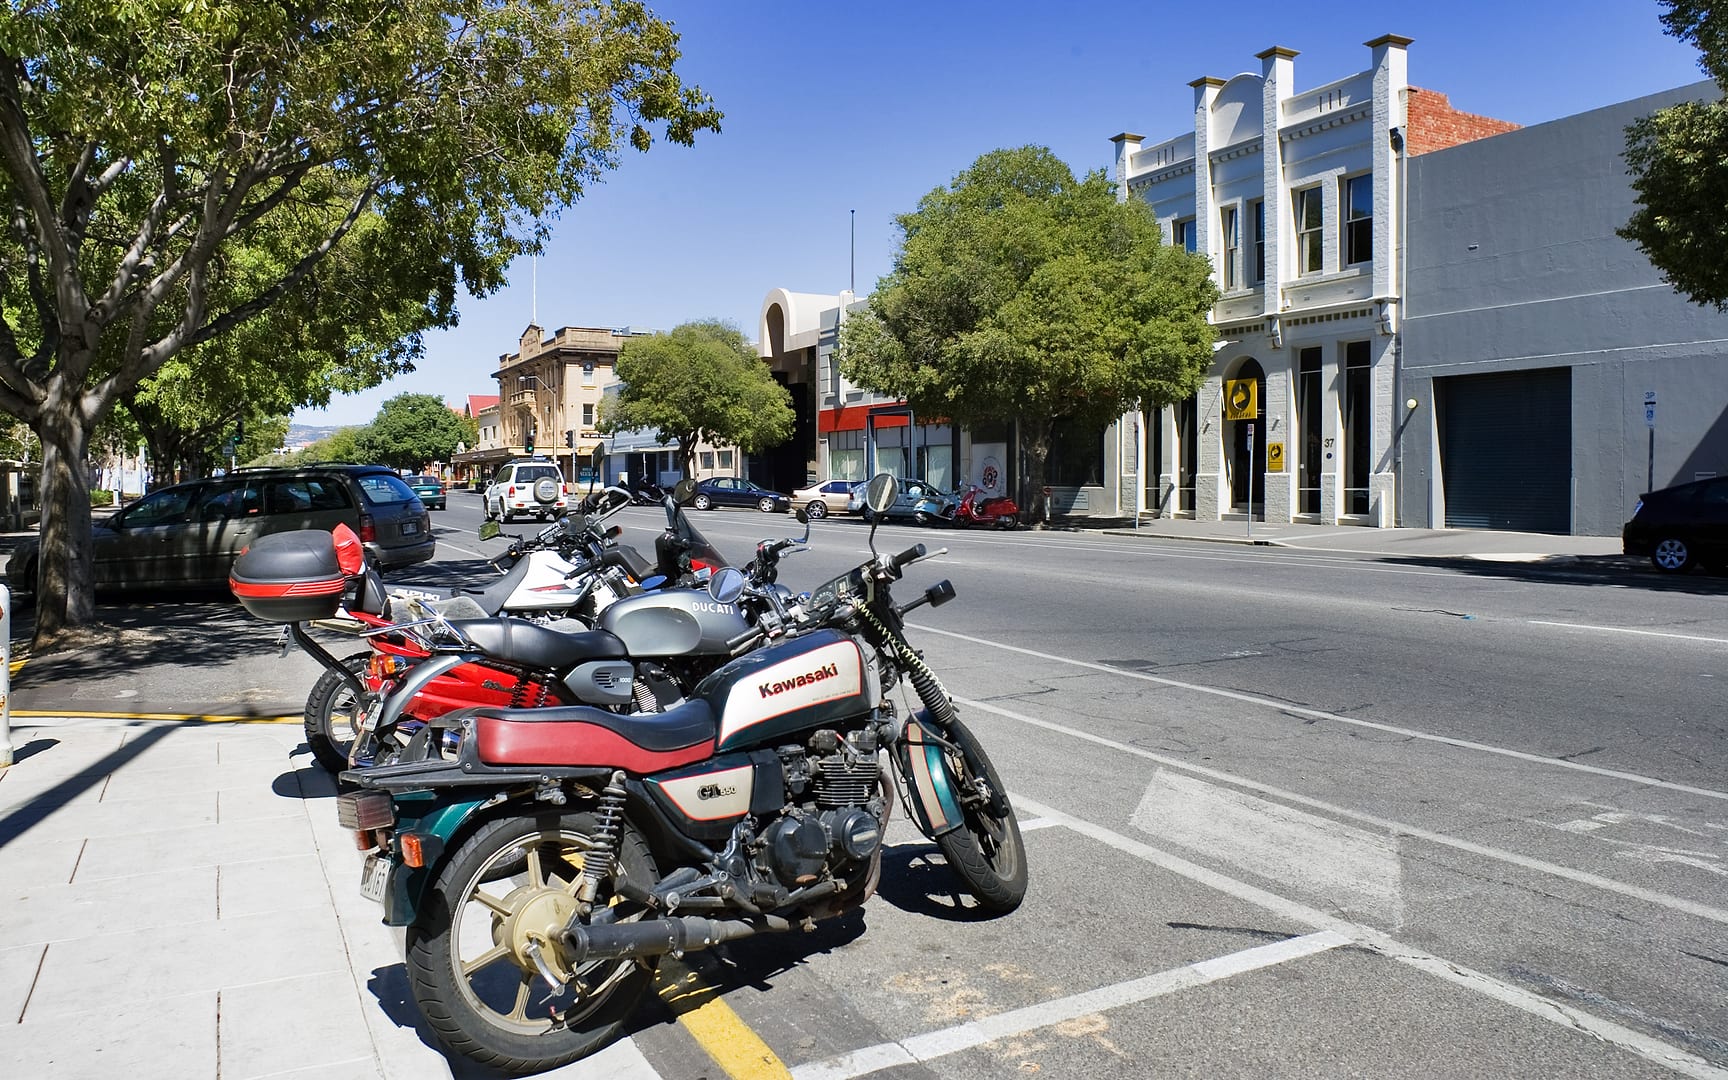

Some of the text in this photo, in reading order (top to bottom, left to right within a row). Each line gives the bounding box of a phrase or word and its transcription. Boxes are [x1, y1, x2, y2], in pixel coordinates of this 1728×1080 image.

[1324, 438, 1335, 448] 37
[692, 601, 734, 615] DUCATI
[758, 662, 839, 699] Kawasaki
